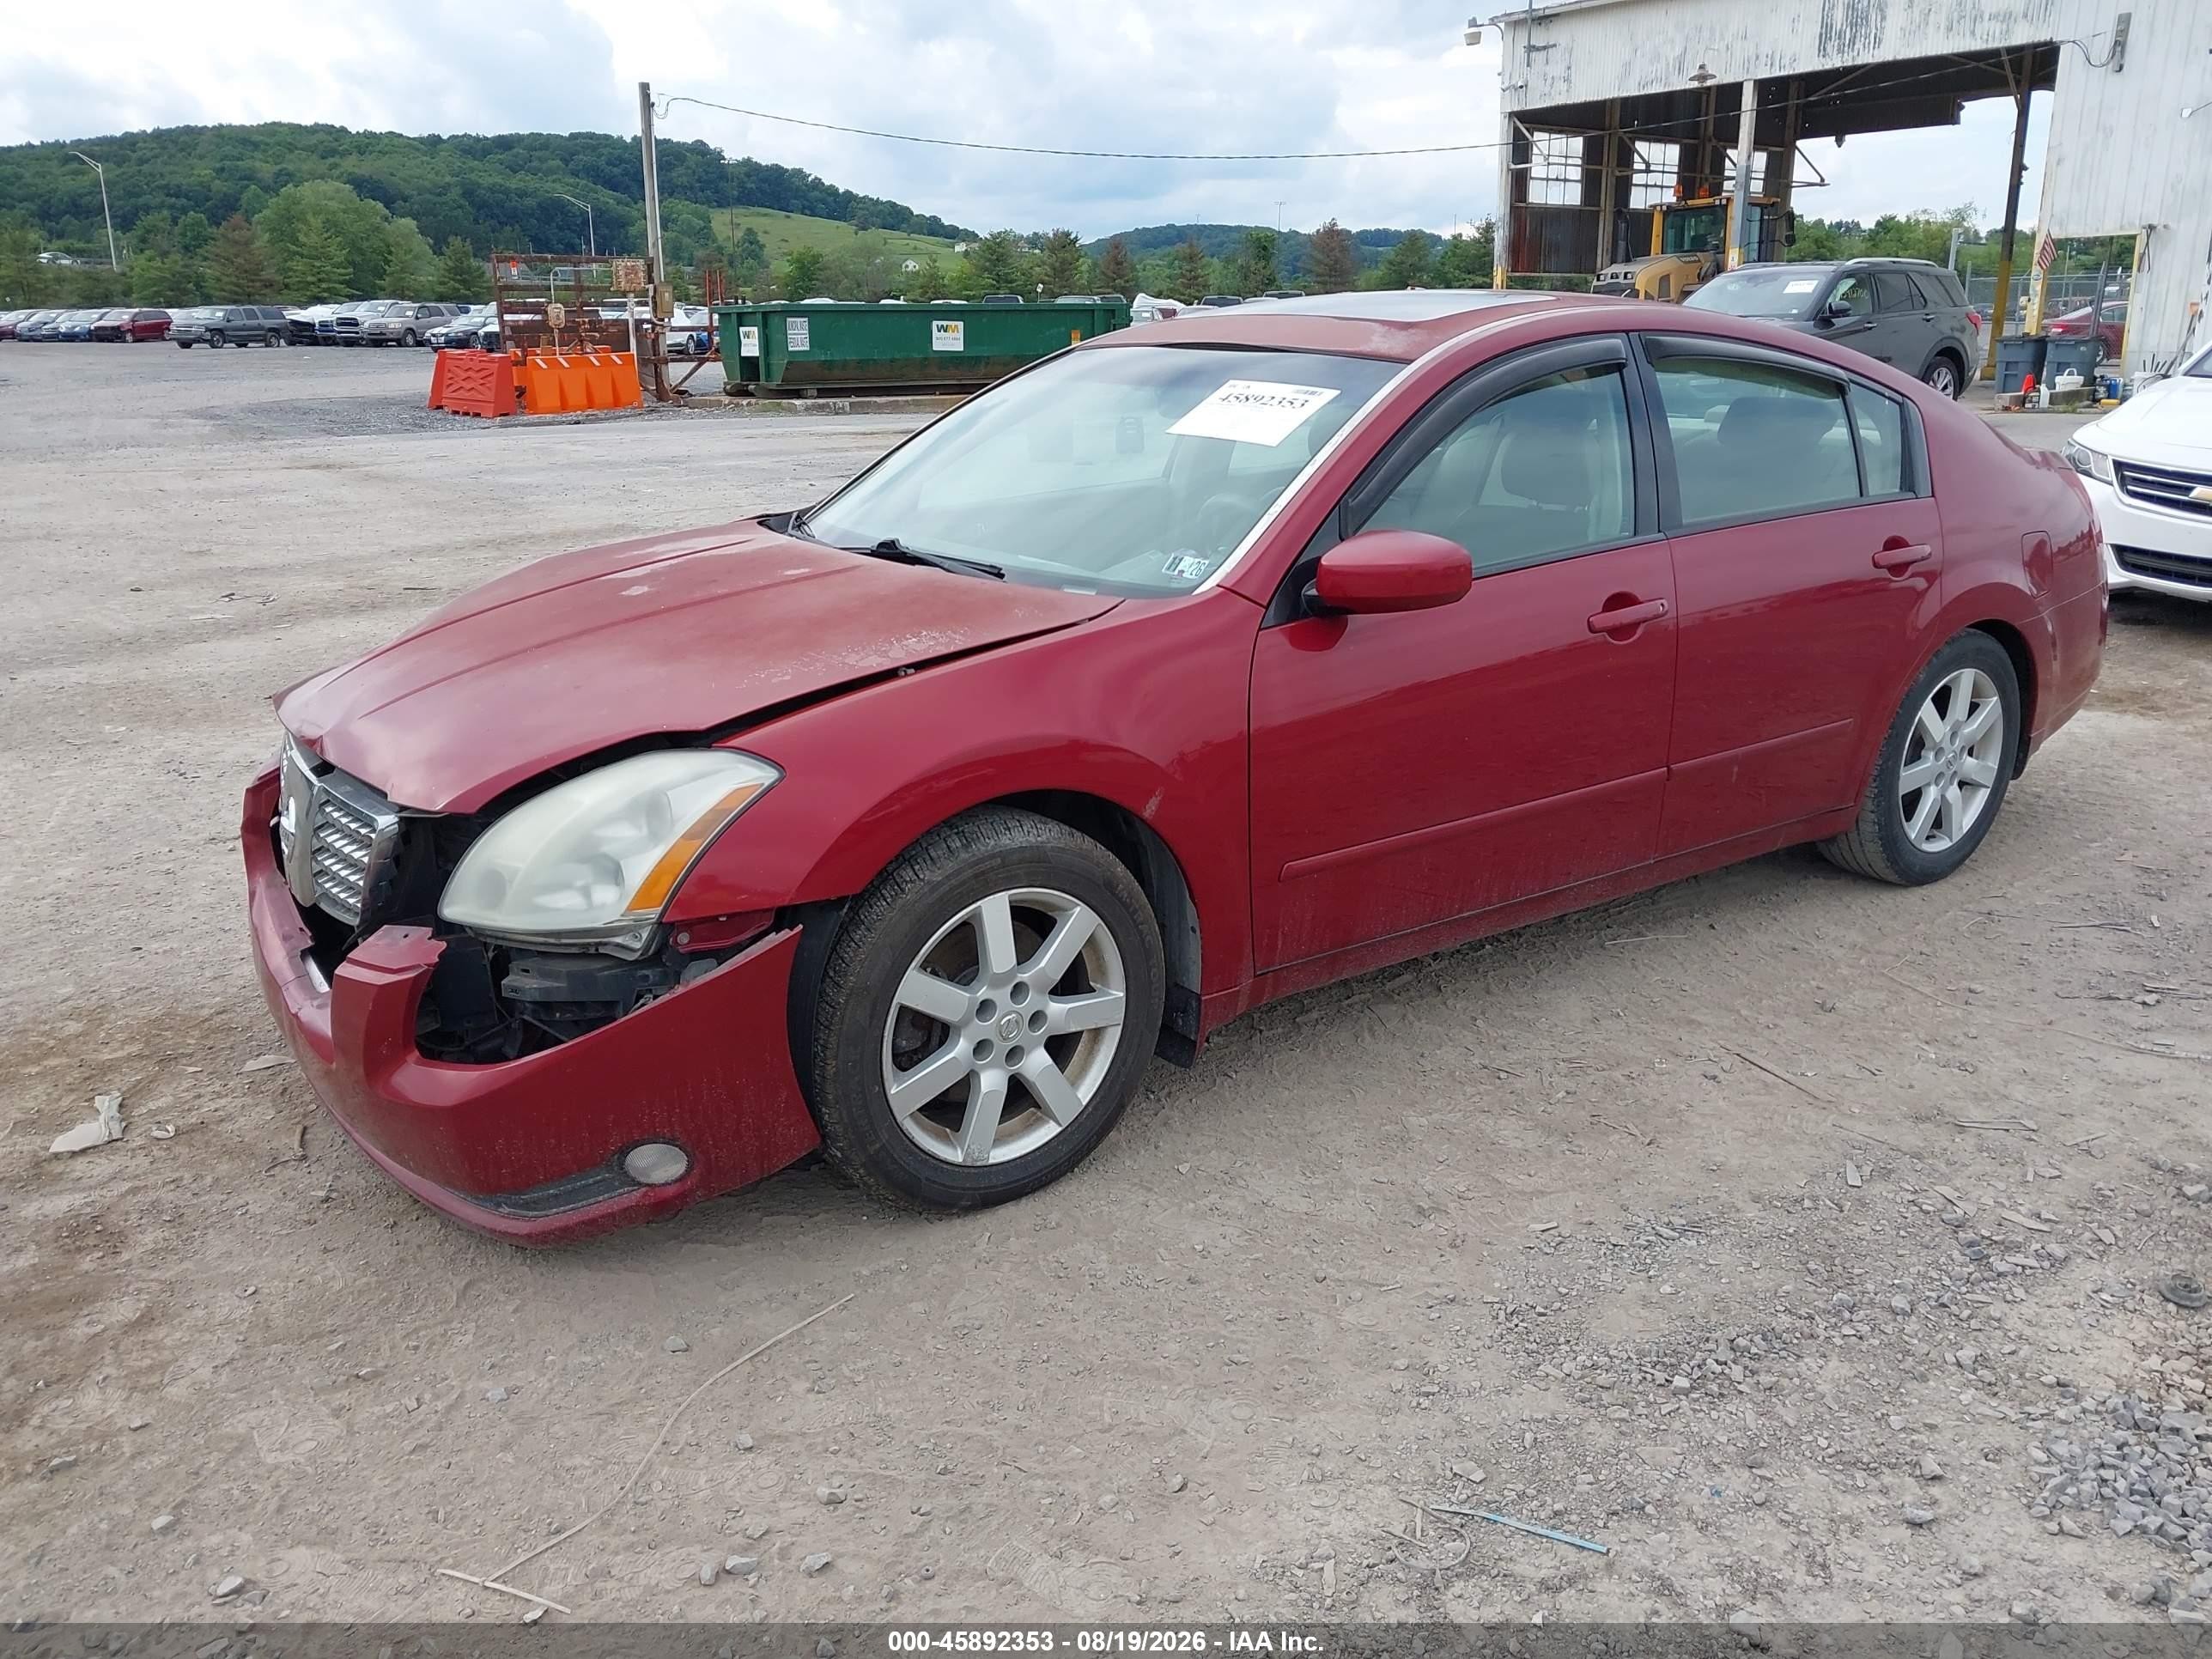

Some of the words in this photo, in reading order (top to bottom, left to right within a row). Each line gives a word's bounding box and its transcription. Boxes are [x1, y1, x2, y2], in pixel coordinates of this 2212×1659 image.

[936, 324, 959, 333] WM
[742, 330, 757, 340] WM
[1218, 392, 1310, 409] 45892353
